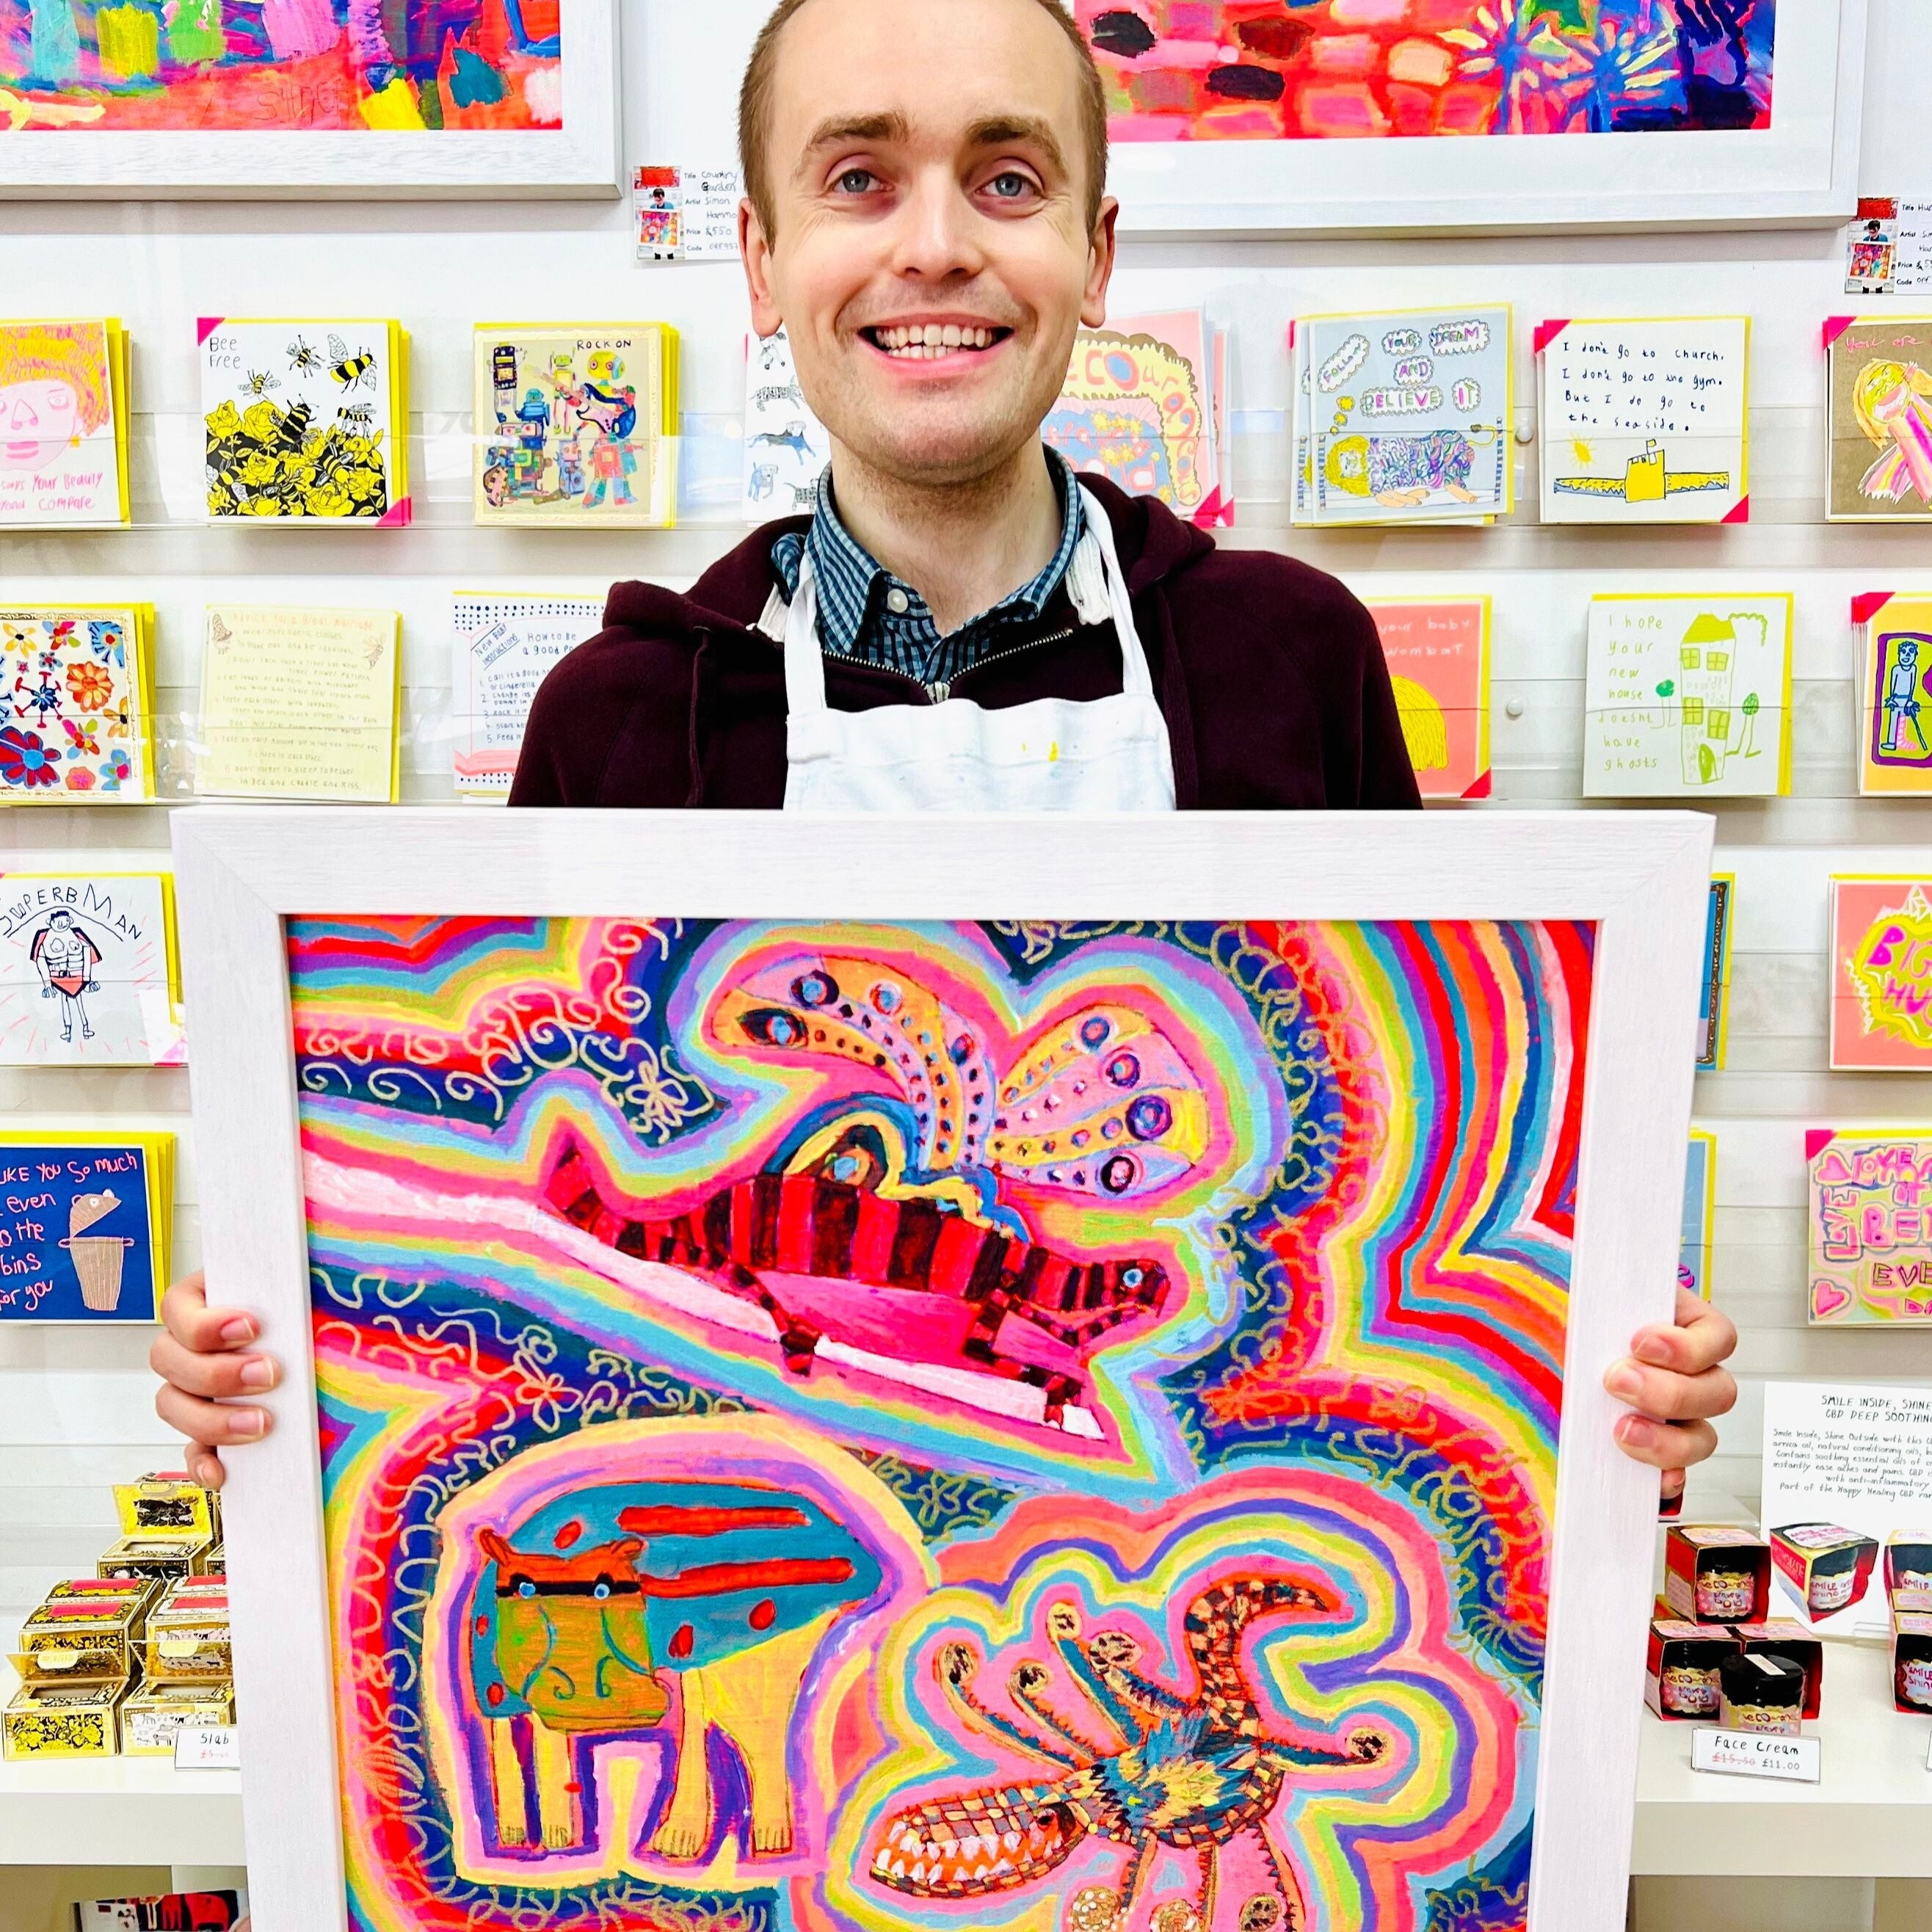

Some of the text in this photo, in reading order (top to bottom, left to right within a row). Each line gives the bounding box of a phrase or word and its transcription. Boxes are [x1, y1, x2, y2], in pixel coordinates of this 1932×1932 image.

[702, 171, 738, 182] Country
[210, 337, 237, 352] Bee
[577, 340, 632, 350] ROCK ON
[1388, 333, 1418, 349] YOUR
[1434, 327, 1479, 346] DREAM
[1563, 342, 1569, 351] I
[1583, 341, 1609, 355] don't
[1618, 344, 1630, 359] go
[1642, 348, 1656, 358] to
[210, 355, 241, 369] Free
[1399, 361, 1429, 377] AND
[1562, 368, 1723, 391] I don't go to the gym.
[1365, 382, 1475, 408] BELIEVE IT
[1565, 390, 1705, 412] But I do go to
[1569, 413, 1598, 424] the
[1379, 617, 1470, 635] your baby
[1608, 615, 1663, 630] I hope
[534, 645, 559, 656] good
[1608, 642, 1653, 656] your
[1609, 668, 1640, 678] new
[1608, 689, 1643, 700] house
[1604, 736, 1640, 747] have
[1605, 758, 1657, 771] ghosts
[94, 1152, 138, 1173] much
[7, 1193, 56, 1213] even
[15, 1218, 45, 1241] the
[1, 1252, 41, 1275] bins
[25, 1279, 53, 1310] you
[1822, 1395, 1932, 1411] SMILE INSIDE, SHINE
[1826, 1409, 1932, 1423] CBD DEEP SOOTHIN
[1773, 1428, 1792, 1437] Smile
[1825, 1431, 1844, 1439] Shine
[1849, 1433, 1878, 1442] Outside
[1884, 1434, 1902, 1443] with
[1908, 1436, 1922, 1444] this
[1776, 1450, 1810, 1459] Contains
[1815, 1453, 1849, 1467] soothing
[1853, 1456, 1889, 1464] essential
[1818, 1442, 1849, 1450] natural
[1853, 1444, 1901, 1459] conditioning
[1837, 1464, 1859, 1472] aches
[1863, 1465, 1878, 1473] and
[1826, 1474, 1844, 1482] with
[1780, 1482, 1914, 1502] Part of the Happy Healing CBD
[200, 1732, 229, 1745] Slab
[1715, 1735, 1798, 1755] Face Cream
[1762, 1758, 1800, 1771] £11.00
